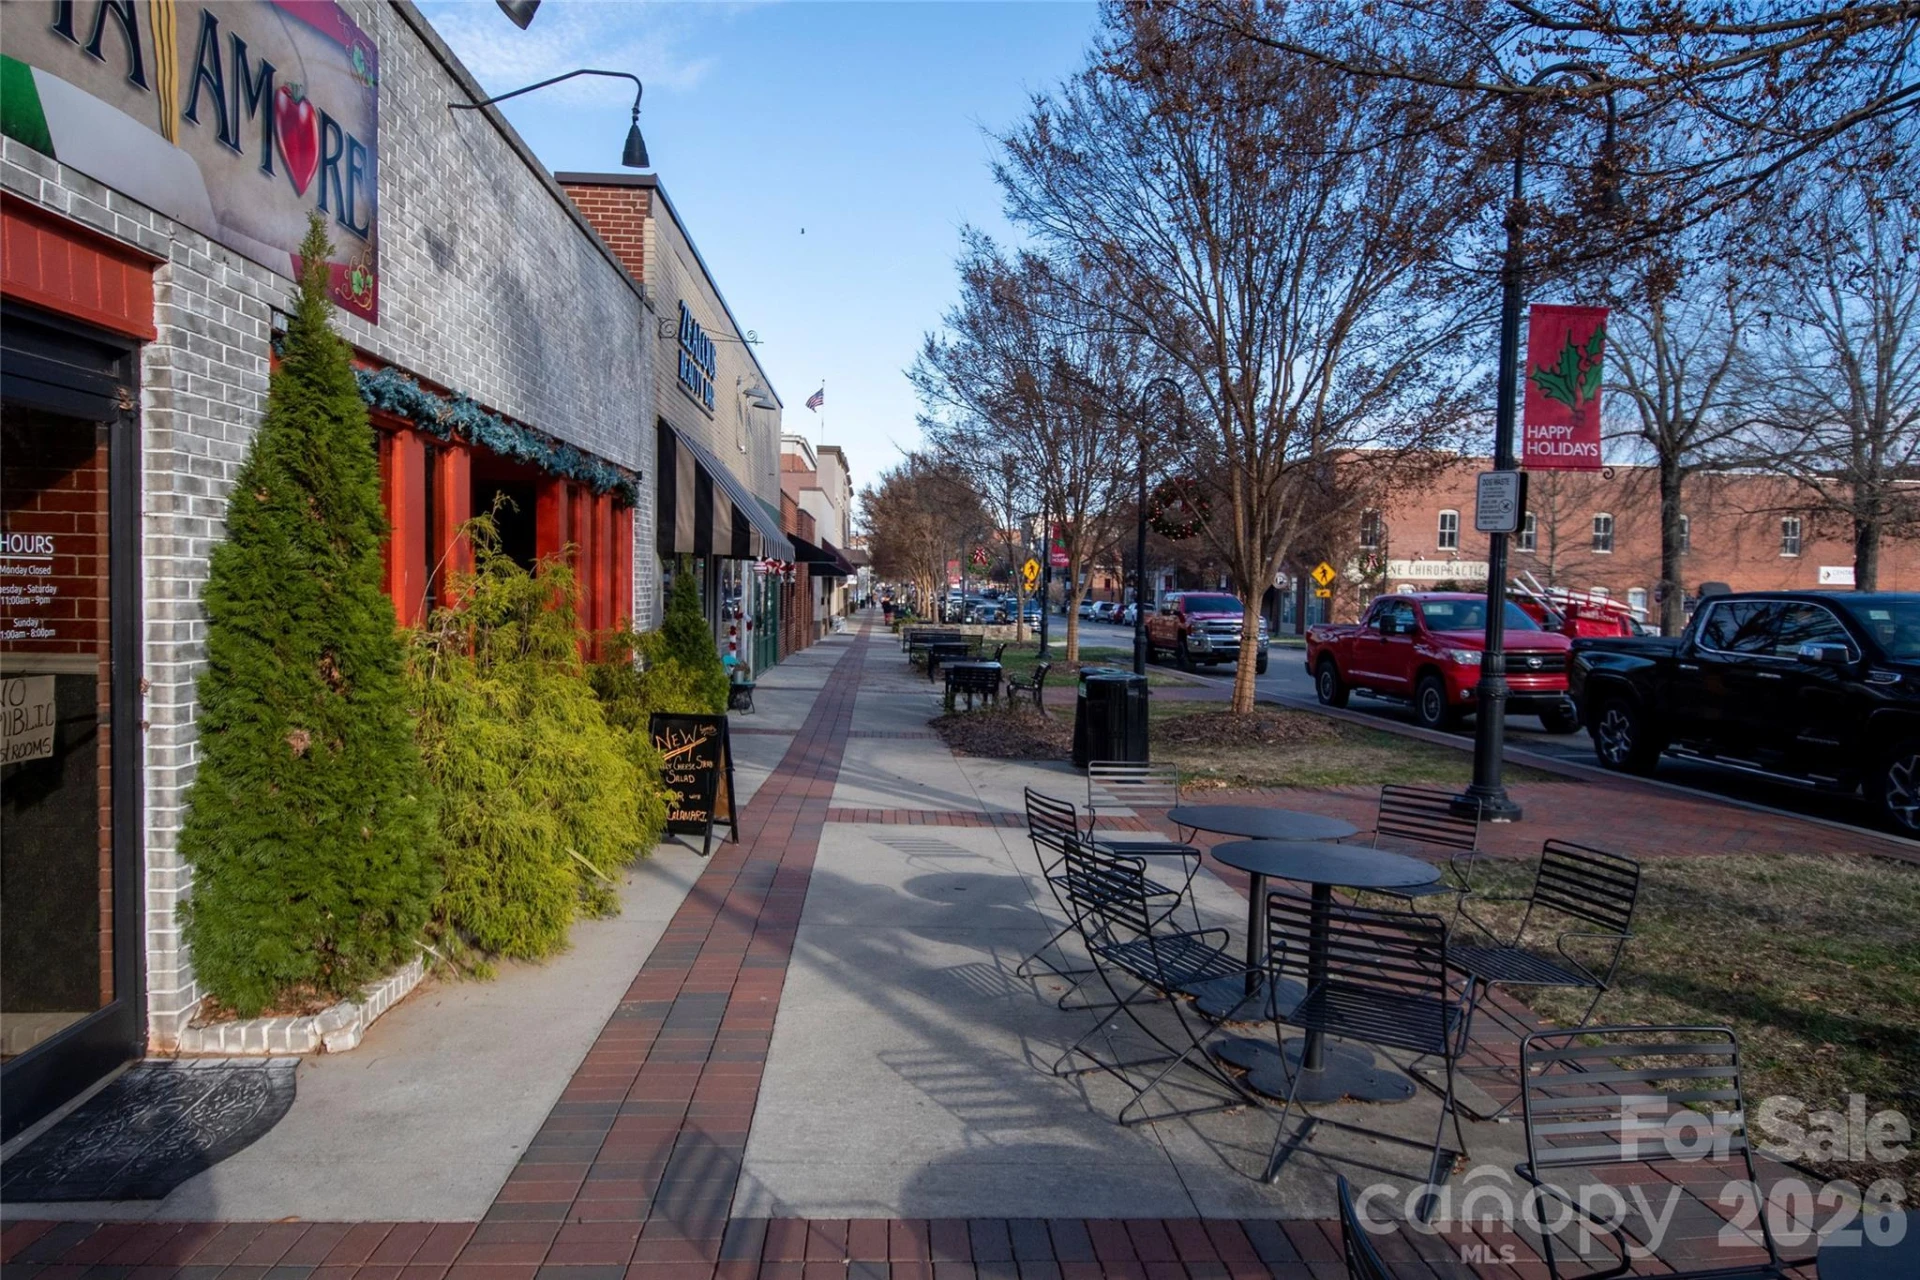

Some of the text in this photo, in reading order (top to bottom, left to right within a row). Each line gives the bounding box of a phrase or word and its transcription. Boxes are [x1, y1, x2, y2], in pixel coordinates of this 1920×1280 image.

[1527, 425, 1574, 440] HAPPY
[1526, 442, 1599, 457] HOLIDAYS
[0, 533, 54, 554] HOURS
[0, 564, 52, 576] Monday Closed
[1408, 564, 1485, 577] CHIROPRACTIC
[27, 583, 57, 595] Saturday
[35, 595, 51, 606] 9pm
[13, 617, 39, 628] Sunday
[30, 627, 56, 639] 8:00pm
[0, 703, 55, 737] UBLIC
[665, 769, 695, 784] SALAD
